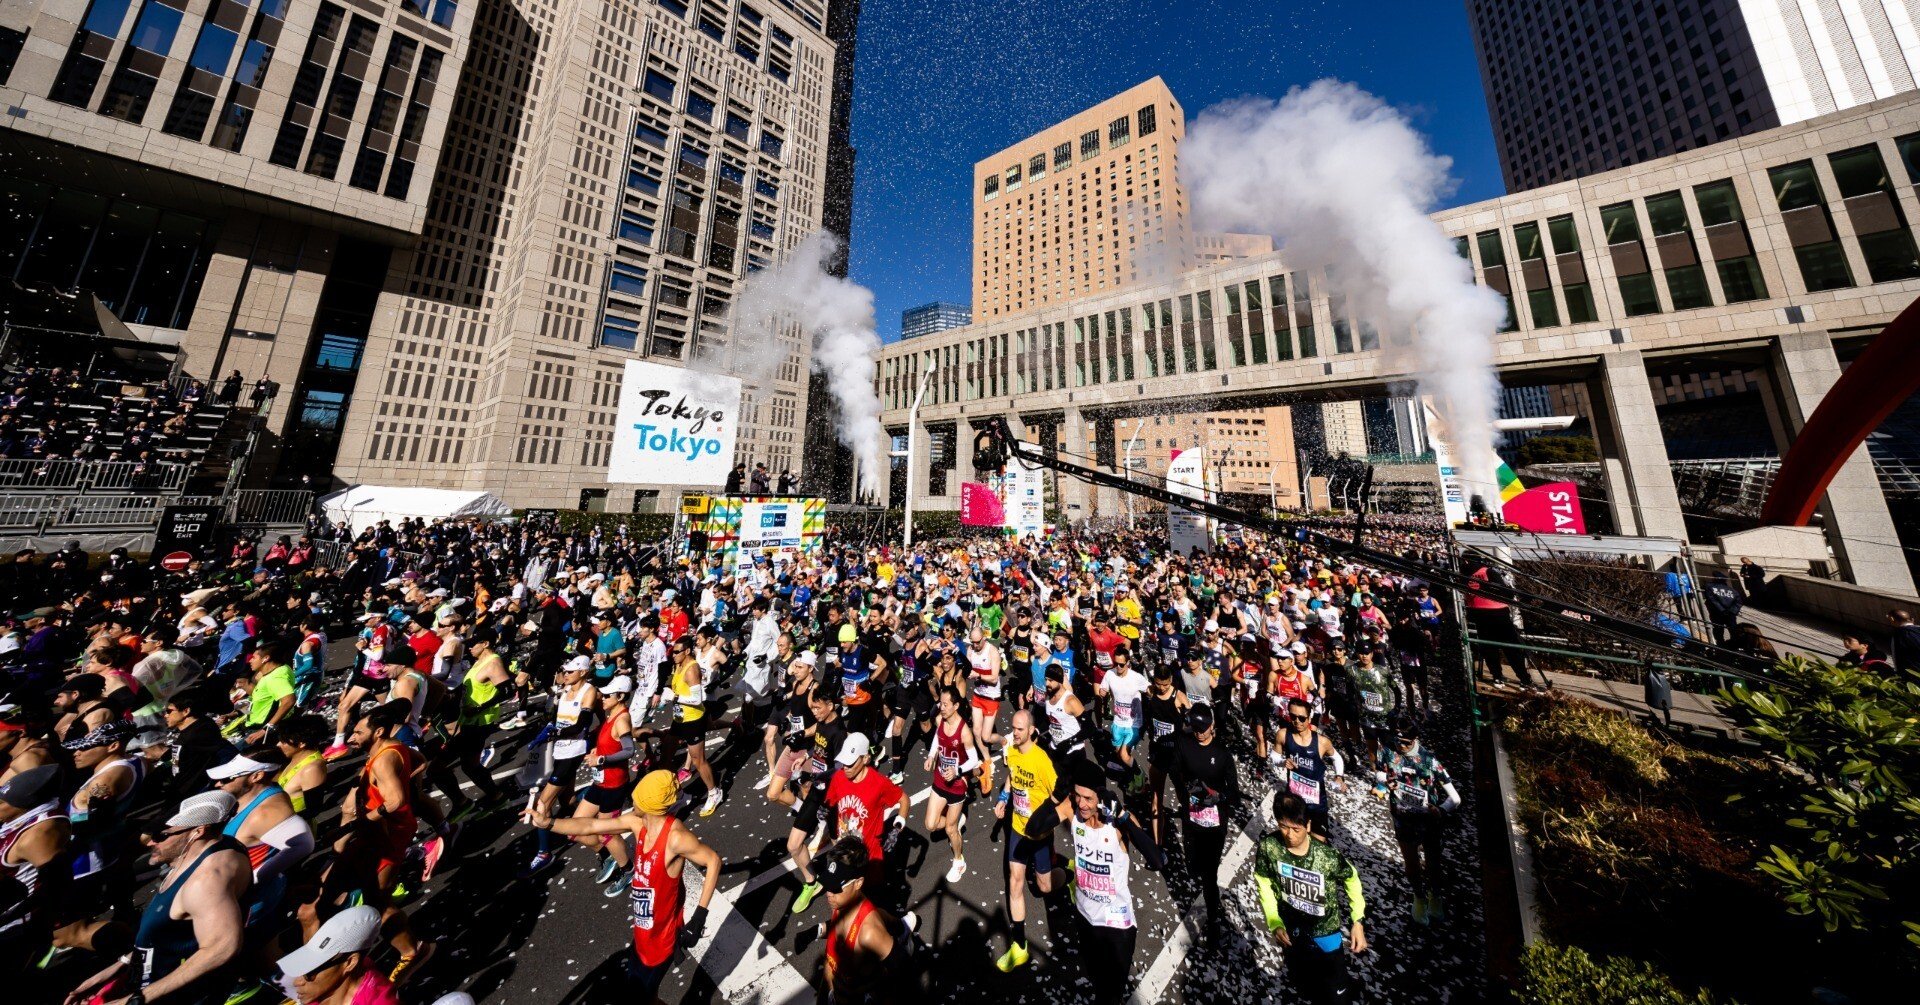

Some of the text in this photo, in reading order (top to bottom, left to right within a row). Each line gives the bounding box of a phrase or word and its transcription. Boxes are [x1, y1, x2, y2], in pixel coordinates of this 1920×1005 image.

[639, 390, 724, 435] Tokyo
[633, 424, 721, 461] Tokyo
[963, 487, 971, 519] START
[173, 523, 200, 532] 出口
[1016, 765, 1034, 779] Team
[1076, 843, 1113, 863] サンドロ
[1290, 880, 1319, 901] 10912
